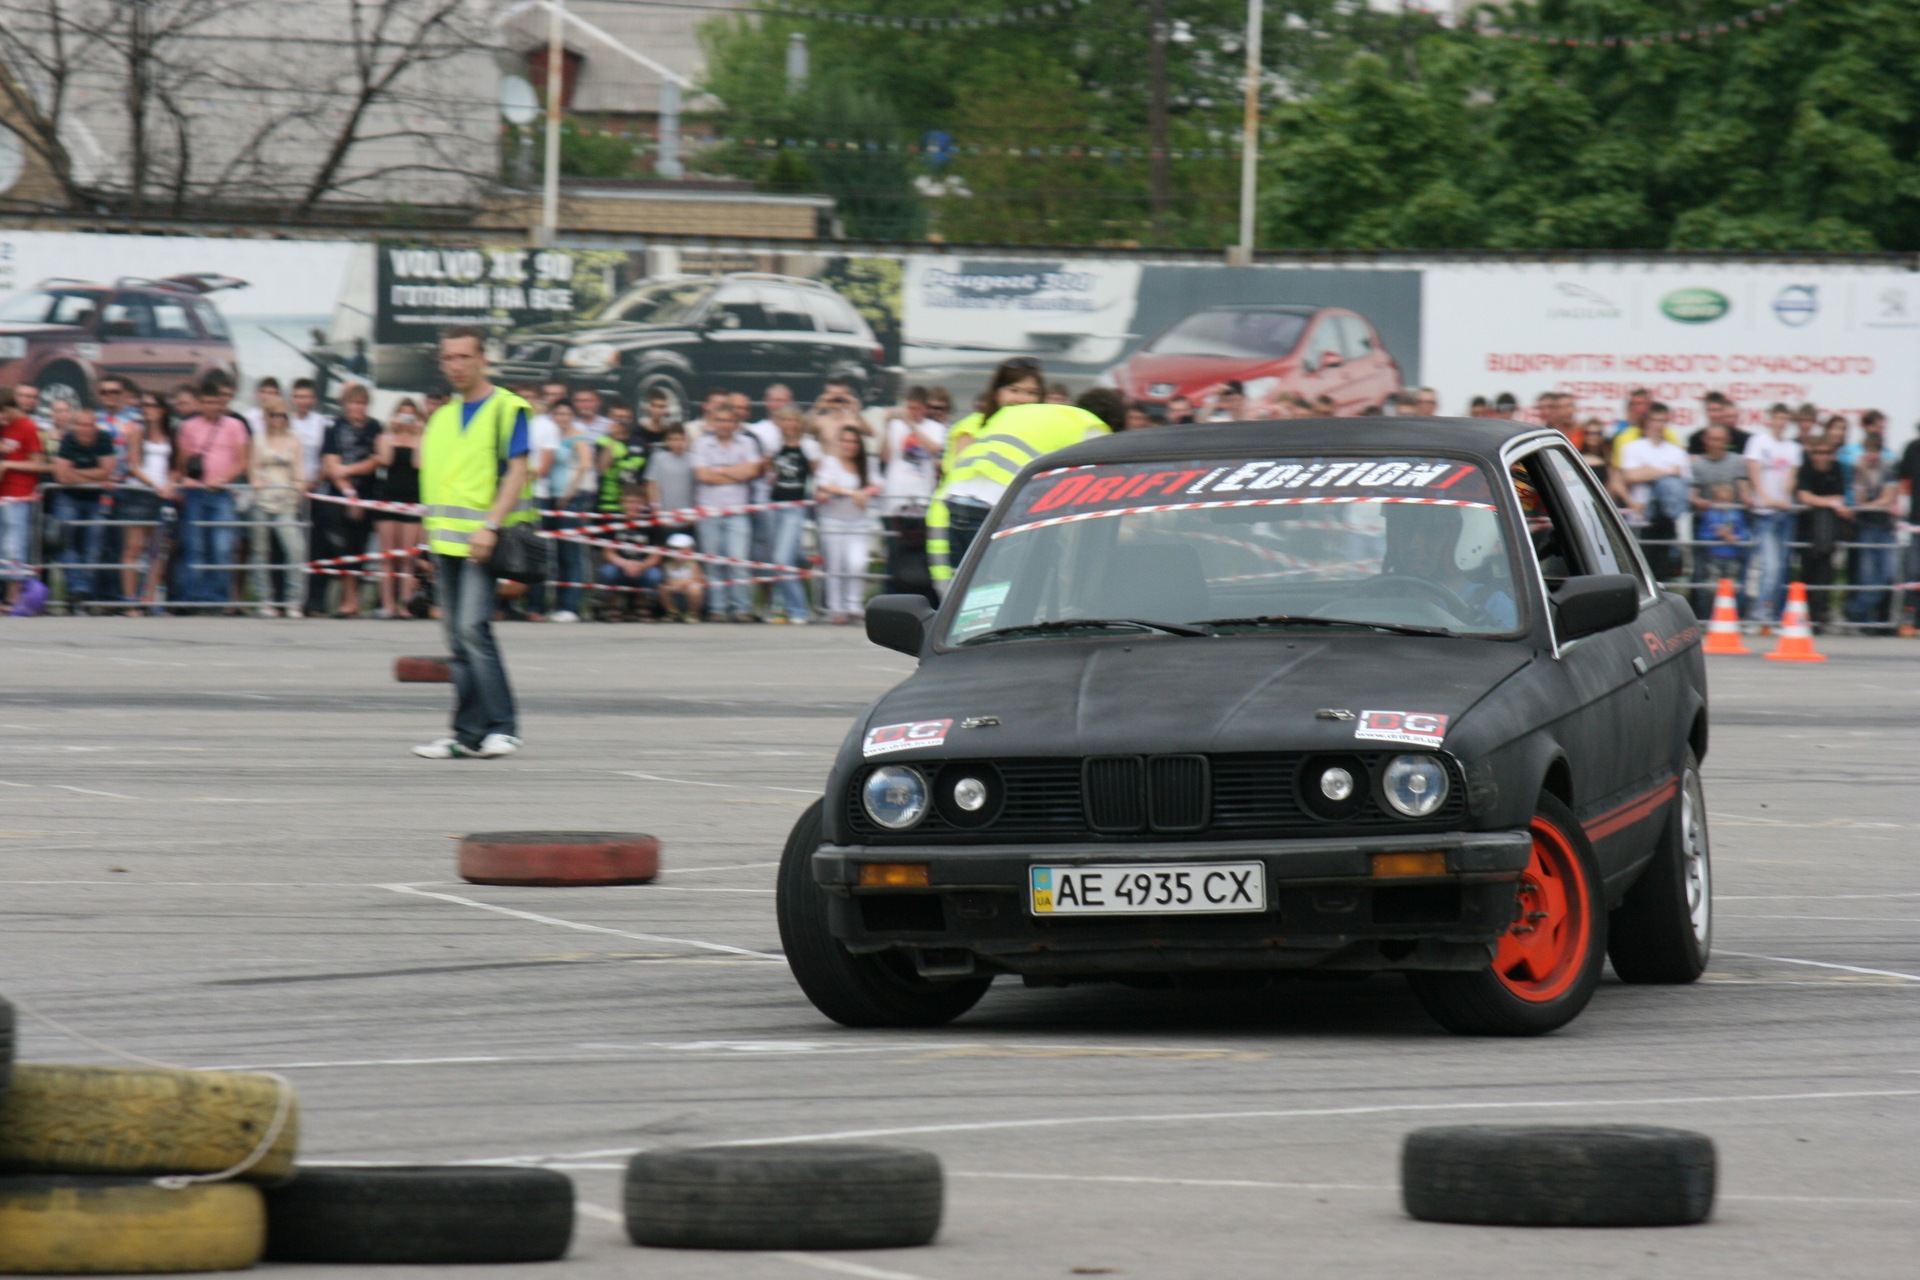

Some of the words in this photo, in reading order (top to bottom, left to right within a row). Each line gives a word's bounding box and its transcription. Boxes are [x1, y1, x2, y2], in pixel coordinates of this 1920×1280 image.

[390, 250, 483, 279] VOLVO
[489, 250, 529, 280] XC
[534, 252, 574, 281] 90
[1624, 353, 1723, 373] НОВОГО
[1728, 355, 1876, 375] СУЧАСНОГО
[1028, 470, 1209, 515] DRIFT
[1036, 897, 1052, 906] UA
[1056, 873, 1104, 906] AE
[1115, 872, 1193, 906] 4935
[1203, 870, 1253, 904] CX
